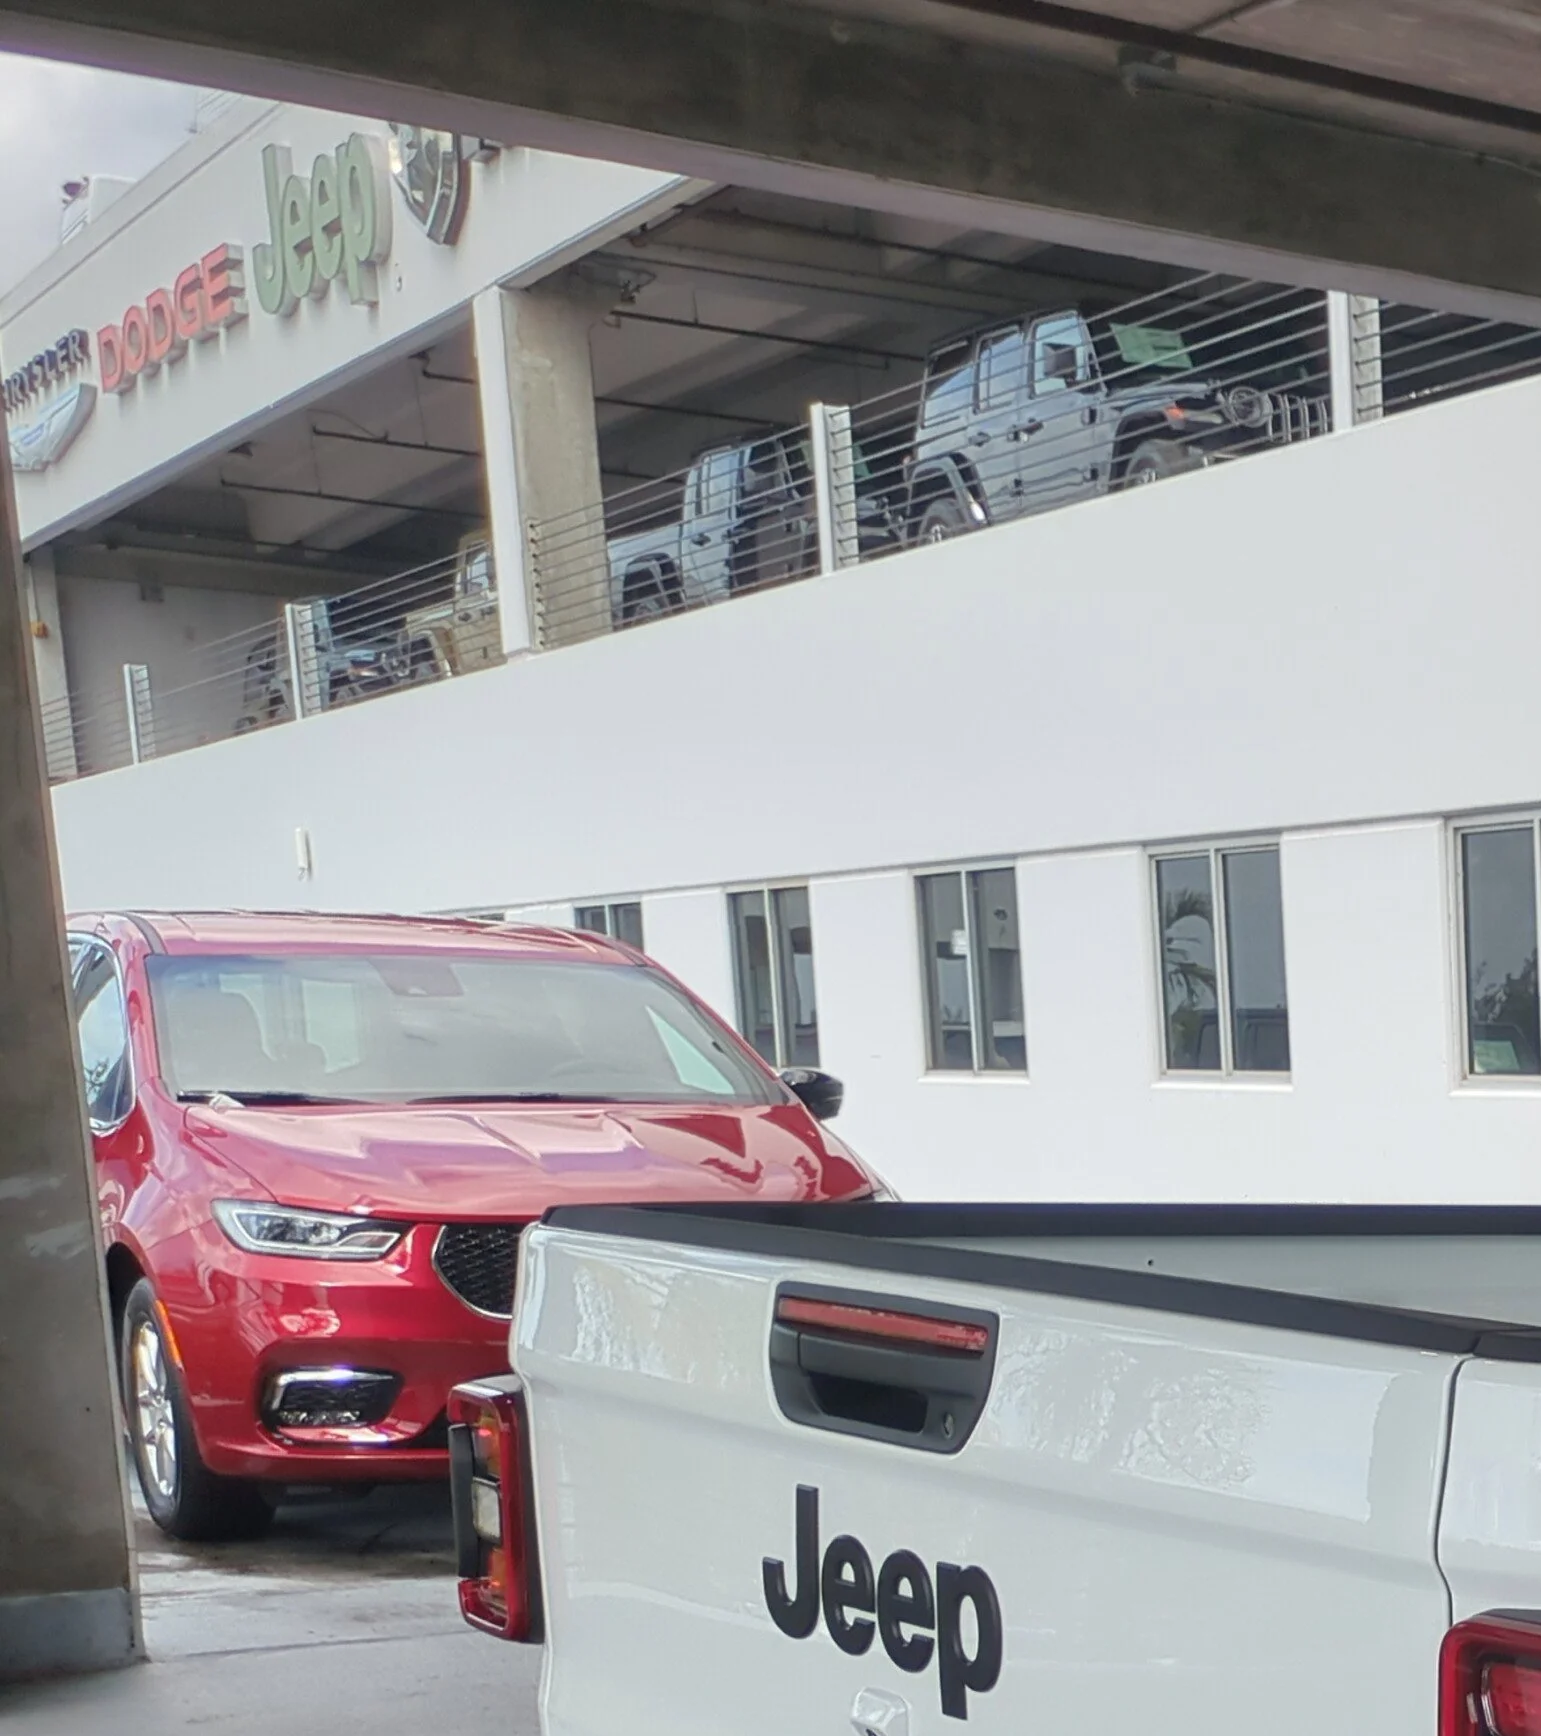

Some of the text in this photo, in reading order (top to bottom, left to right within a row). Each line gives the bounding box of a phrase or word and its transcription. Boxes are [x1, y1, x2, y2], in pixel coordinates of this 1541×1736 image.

[252, 131, 392, 316] Jeep
[97, 242, 246, 393] DODGE
[762, 1484, 1004, 1721] Jeep
